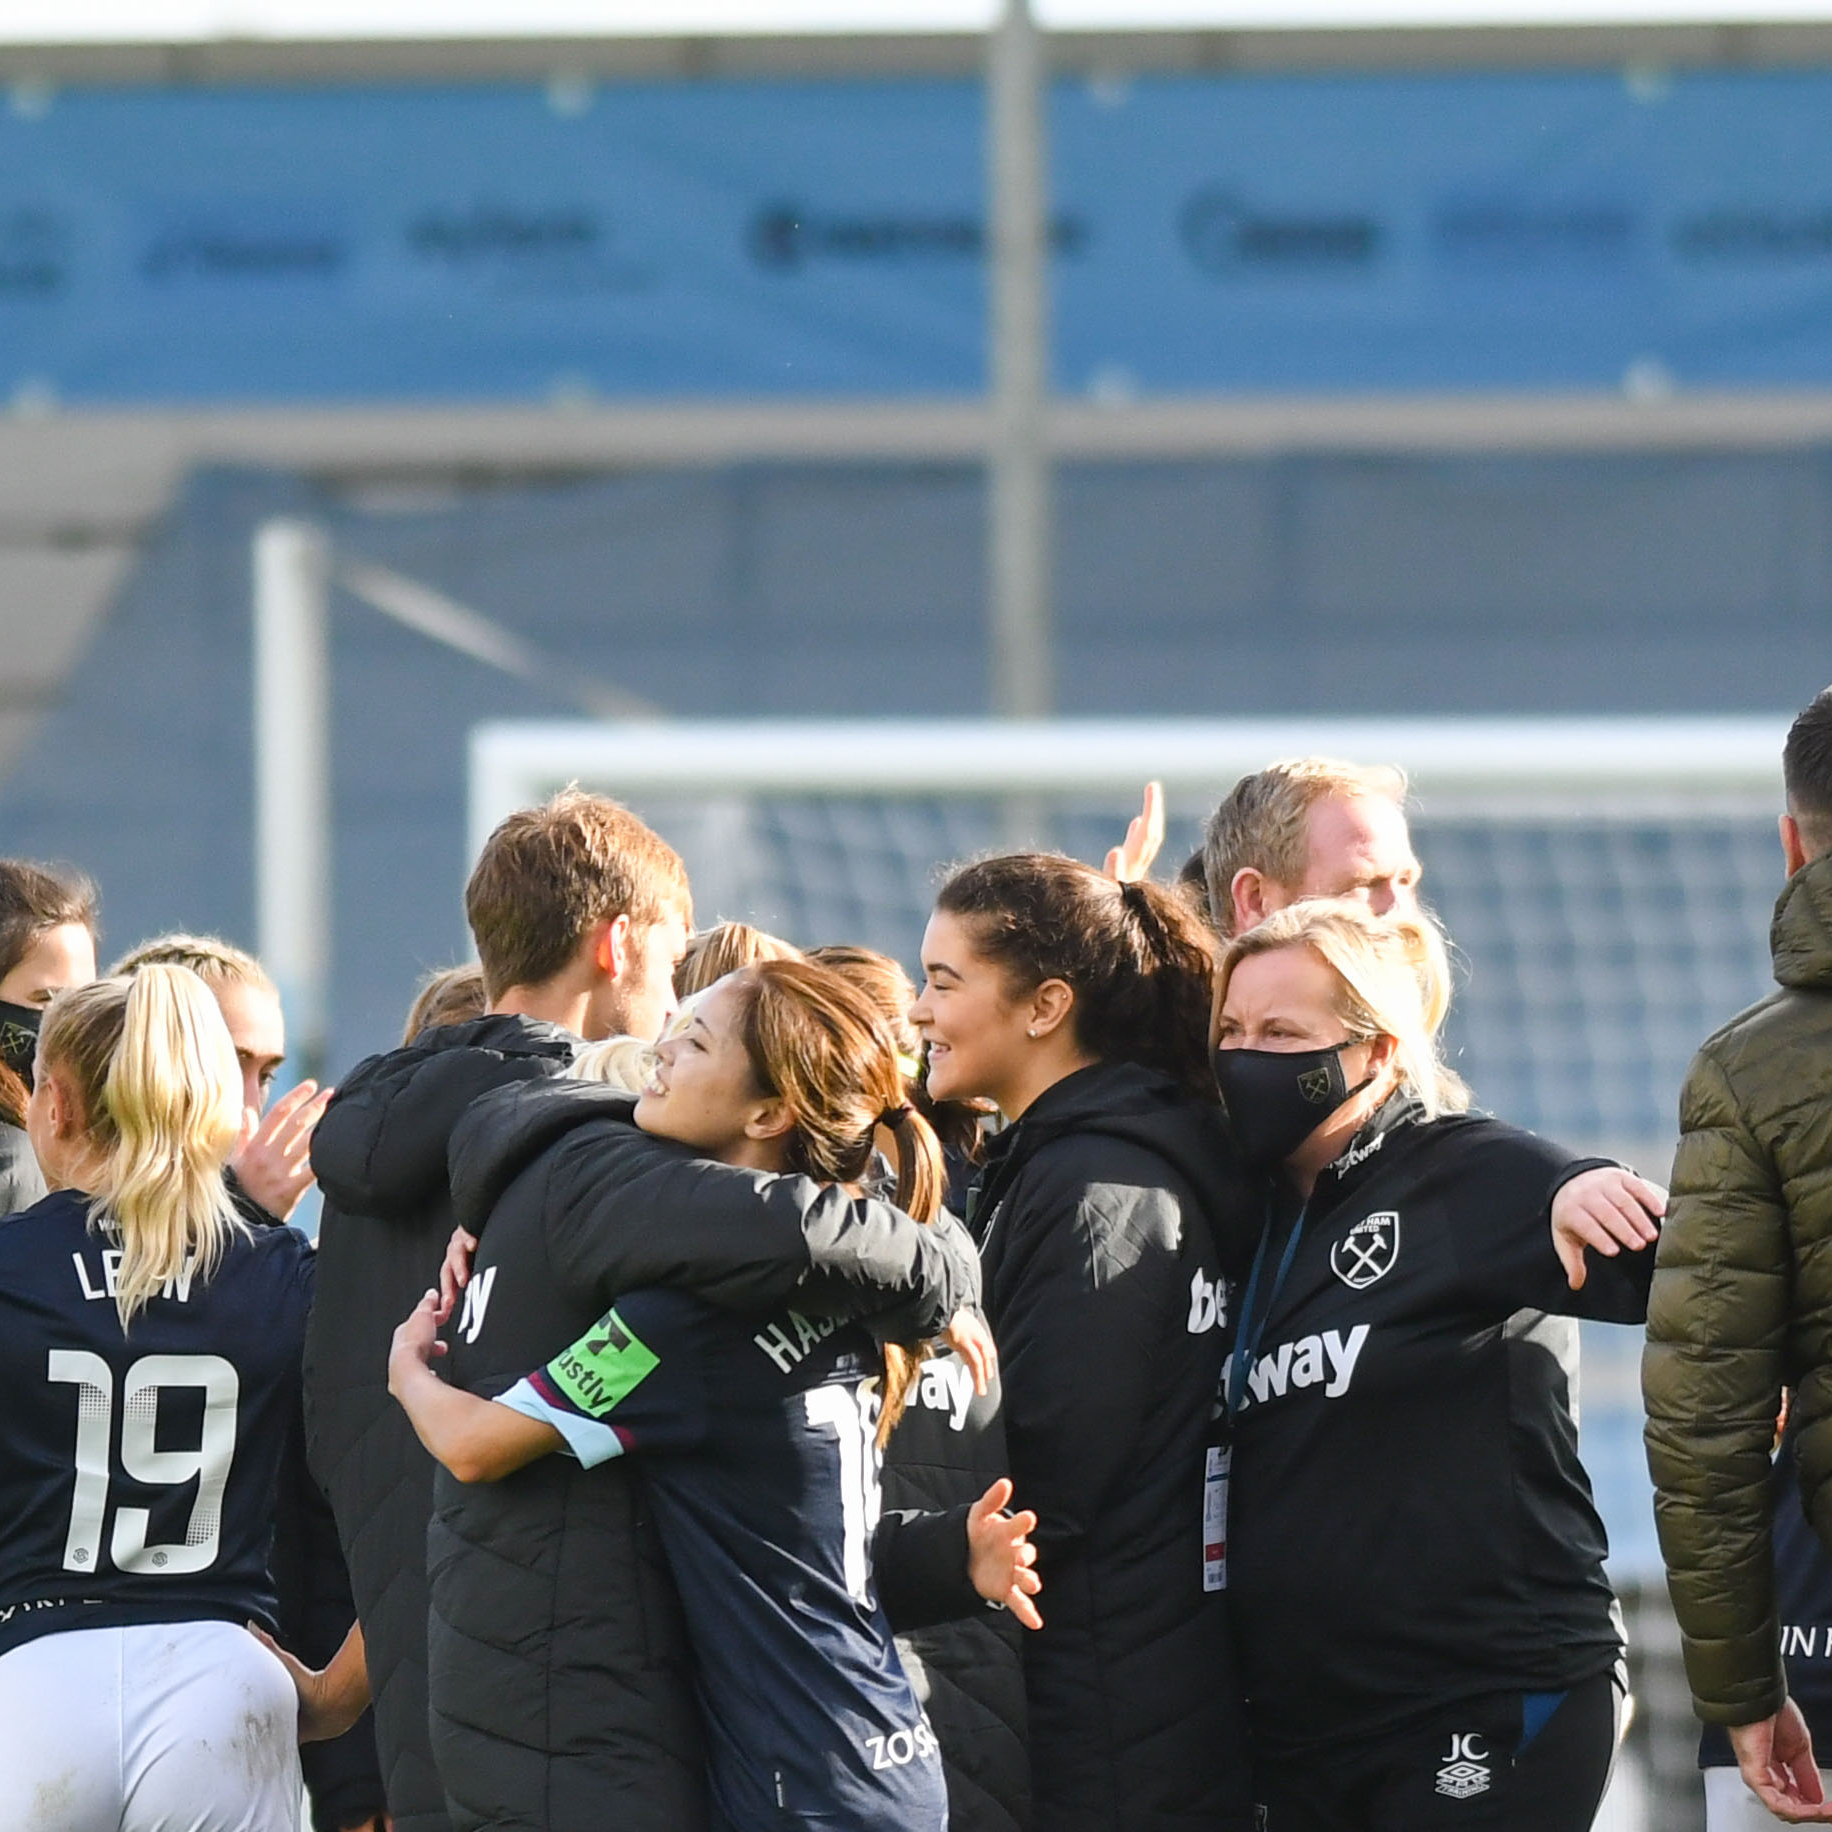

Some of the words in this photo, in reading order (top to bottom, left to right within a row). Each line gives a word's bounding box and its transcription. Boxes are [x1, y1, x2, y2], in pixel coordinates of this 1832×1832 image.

[72, 1250, 195, 1303] LEN
[558, 1349, 613, 1410] ustly
[49, 1348, 240, 1576] 19
[1779, 1625, 1817, 1658] IN
[1441, 1732, 1490, 1762] JC
